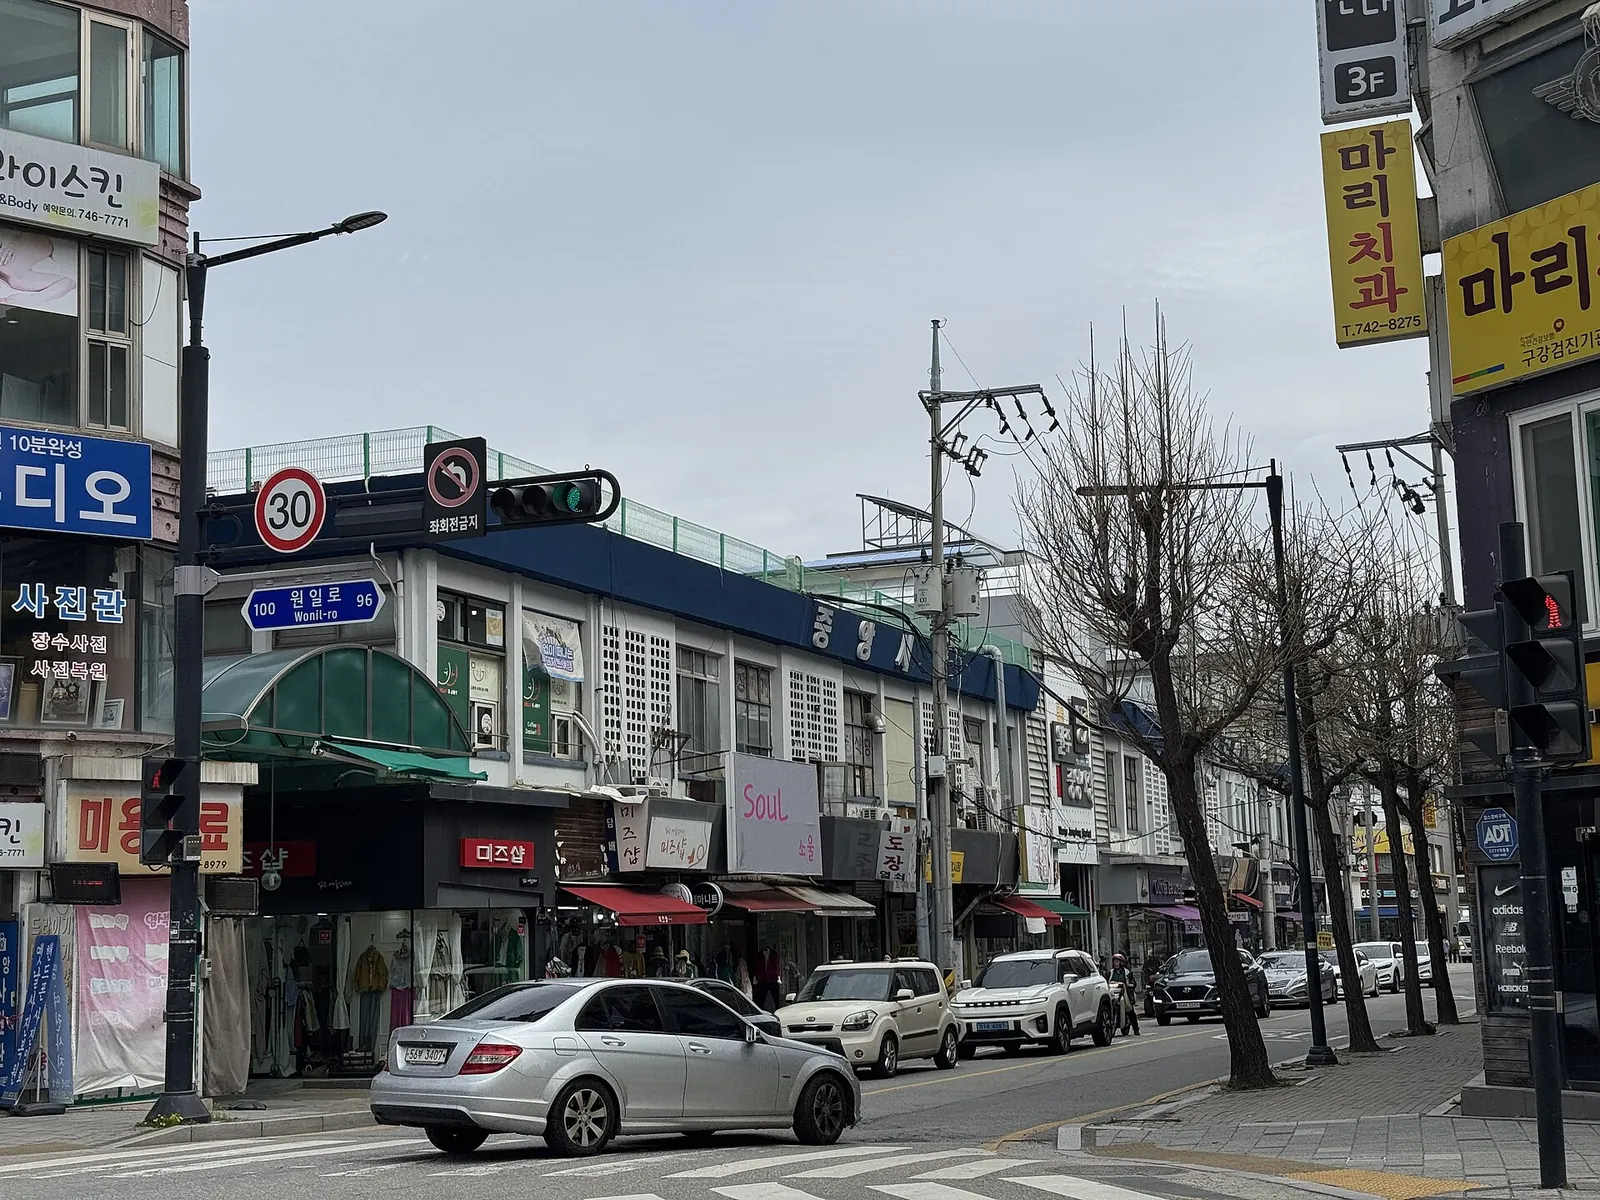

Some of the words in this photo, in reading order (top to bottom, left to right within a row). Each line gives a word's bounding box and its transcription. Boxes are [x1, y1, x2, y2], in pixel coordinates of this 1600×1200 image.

[1347, 66, 1385, 97] 3F
[1337, 129, 1409, 314] 마리치과
[1458, 224, 1600, 317] 마리
[1342, 314, 1422, 338] T.742-8275
[0, 463, 137, 525] 디오
[268, 490, 312, 530] 30
[429, 514, 479, 536] 좌회전금지
[11, 582, 127, 624] 사진관
[253, 602, 276, 616] 100
[289, 586, 342, 609] 원일로
[356, 593, 373, 608] 96
[294, 609, 338, 622] Wonil-ro
[30, 631, 108, 654] 장수사진
[30, 659, 108, 681] 사진복원
[606, 817, 617, 853] 담배
[620, 805, 641, 866] 미즈샵
[1484, 824, 1511, 844] ADT
[476, 843, 525, 864] 미즈샵
[660, 838, 688, 861] 미즈샵
[798, 834, 815, 862] 소울
[884, 835, 905, 872] 도장
[1492, 904, 1524, 915] adidas
[1495, 944, 1527, 954] Reebok
[424, 1050, 444, 1061] 3407
